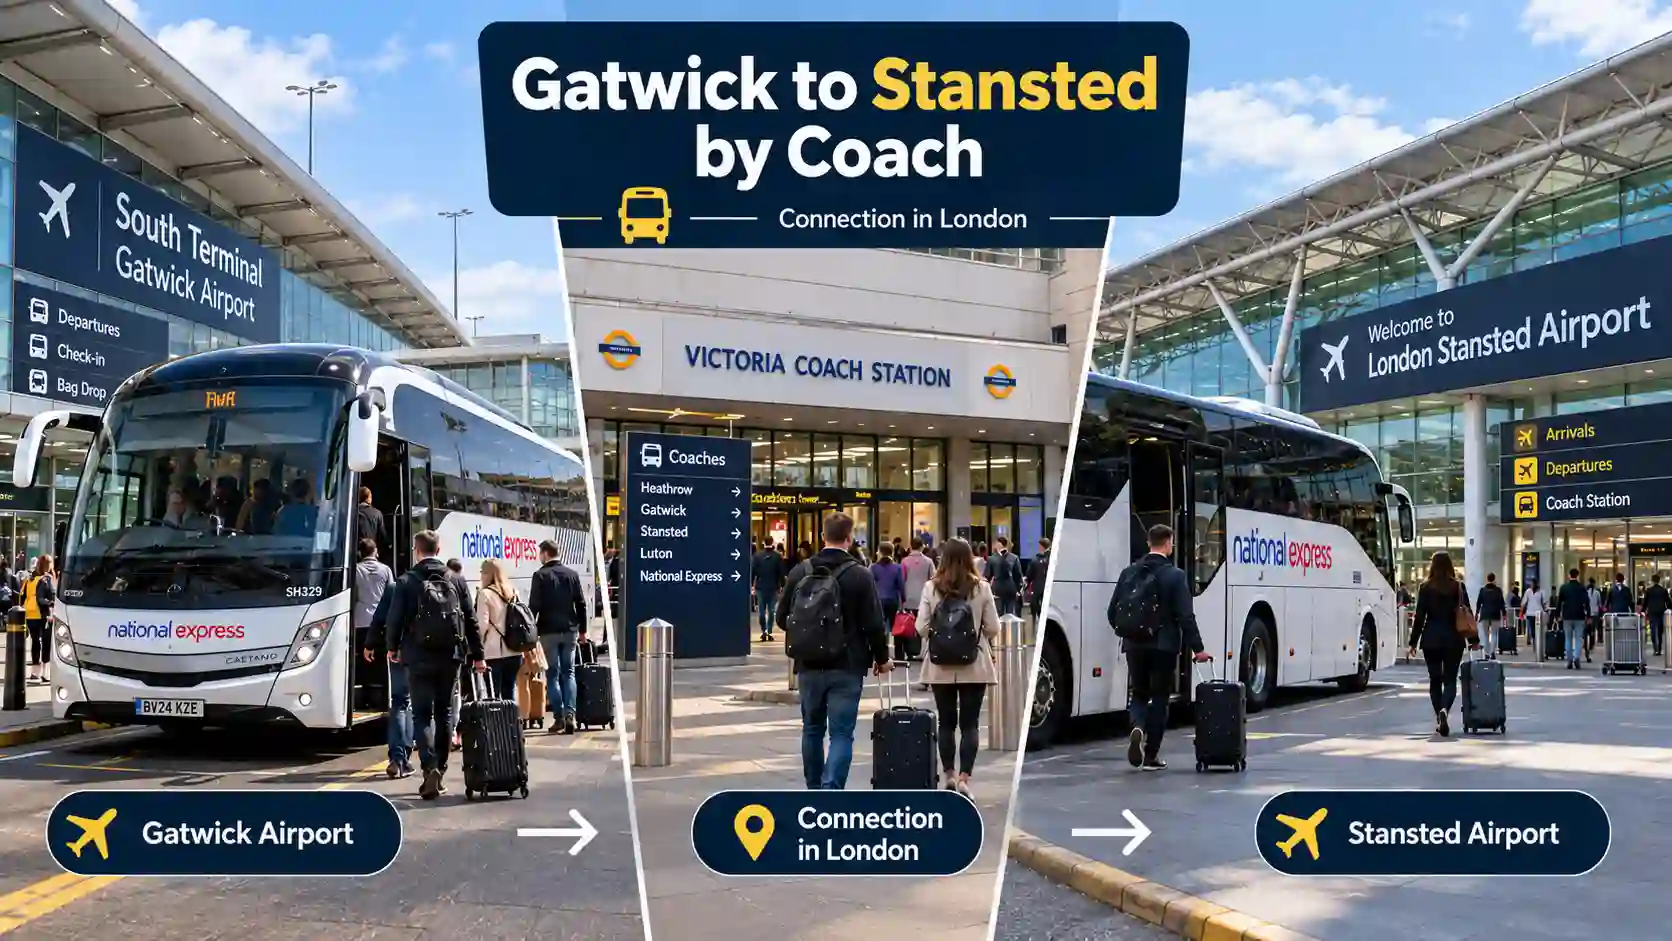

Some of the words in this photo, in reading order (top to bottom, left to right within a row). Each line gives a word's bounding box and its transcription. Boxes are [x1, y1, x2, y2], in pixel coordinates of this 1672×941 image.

[115, 191, 181, 253] South
[187, 223, 263, 288] Terminal
[115, 245, 195, 301] Gatwick
[200, 277, 255, 322] Airport
[58, 308, 121, 338] Departures
[1368, 313, 1433, 343] Welcome
[1437, 308, 1455, 327] to
[1368, 344, 1433, 378] London
[1437, 316, 1531, 365] Stansted
[1538, 296, 1652, 349] Airport
[57, 343, 105, 367] Check-in
[684, 345, 786, 374] VICTORIA
[794, 355, 864, 381] COACH
[871, 362, 951, 388] STATION
[57, 377, 78, 398] Bag
[81, 381, 107, 401] Drop
[1546, 423, 1595, 441] Arrivals
[669, 449, 726, 466] Coaches
[1546, 459, 1613, 477] Departures
[640, 482, 693, 496] Heathrow
[640, 503, 687, 517] Gatwick
[1546, 495, 1583, 511] Coach
[1585, 492, 1631, 509] Station
[640, 525, 688, 539] Stansted
[463, 525, 502, 559] national
[503, 536, 536, 567] express
[640, 547, 673, 560] Luton
[1233, 528, 1287, 565] national
[1289, 541, 1332, 576] express
[640, 570, 682, 584] National
[685, 570, 722, 584] Express
[286, 586, 323, 598] SH329
[108, 620, 173, 640] national
[176, 625, 245, 643] express
[225, 653, 278, 665] CAETANO
[143, 700, 173, 714] BV24
[175, 701, 198, 715] KZE
